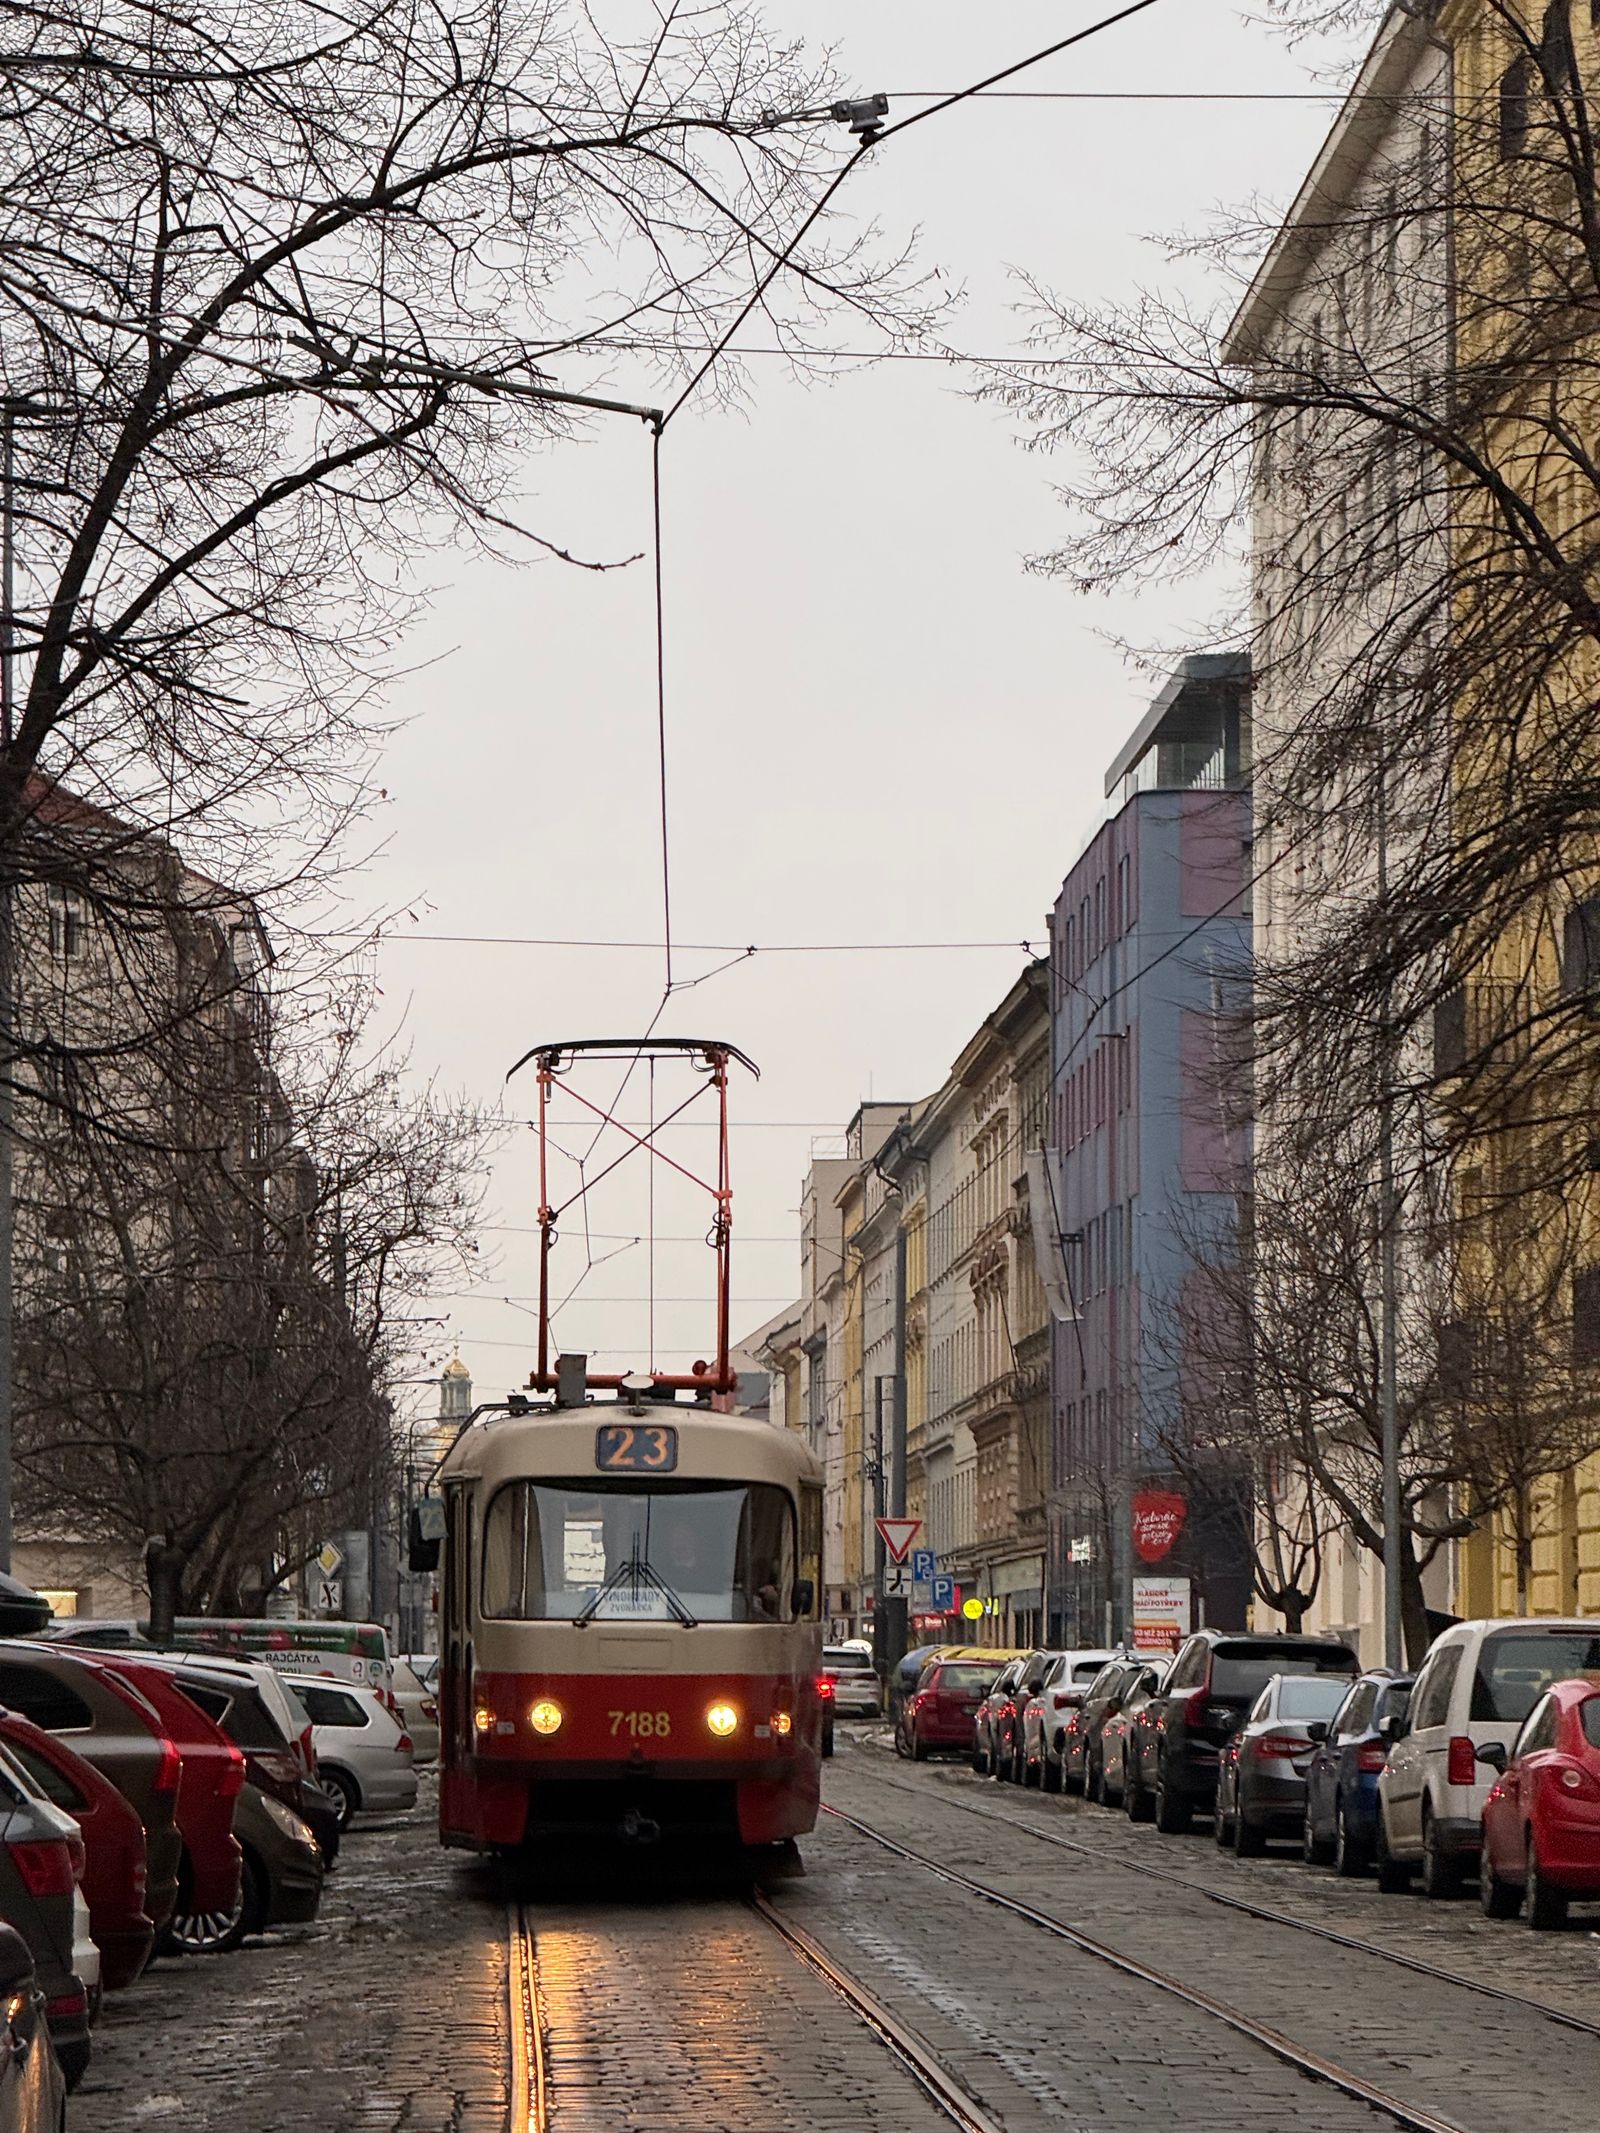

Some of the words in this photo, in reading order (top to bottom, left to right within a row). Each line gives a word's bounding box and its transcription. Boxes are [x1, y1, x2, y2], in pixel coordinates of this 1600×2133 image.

[607, 1427, 668, 1465] 23
[917, 1553, 931, 1573] P
[935, 1581, 949, 1601] P
[608, 1711, 671, 1737] 7188
